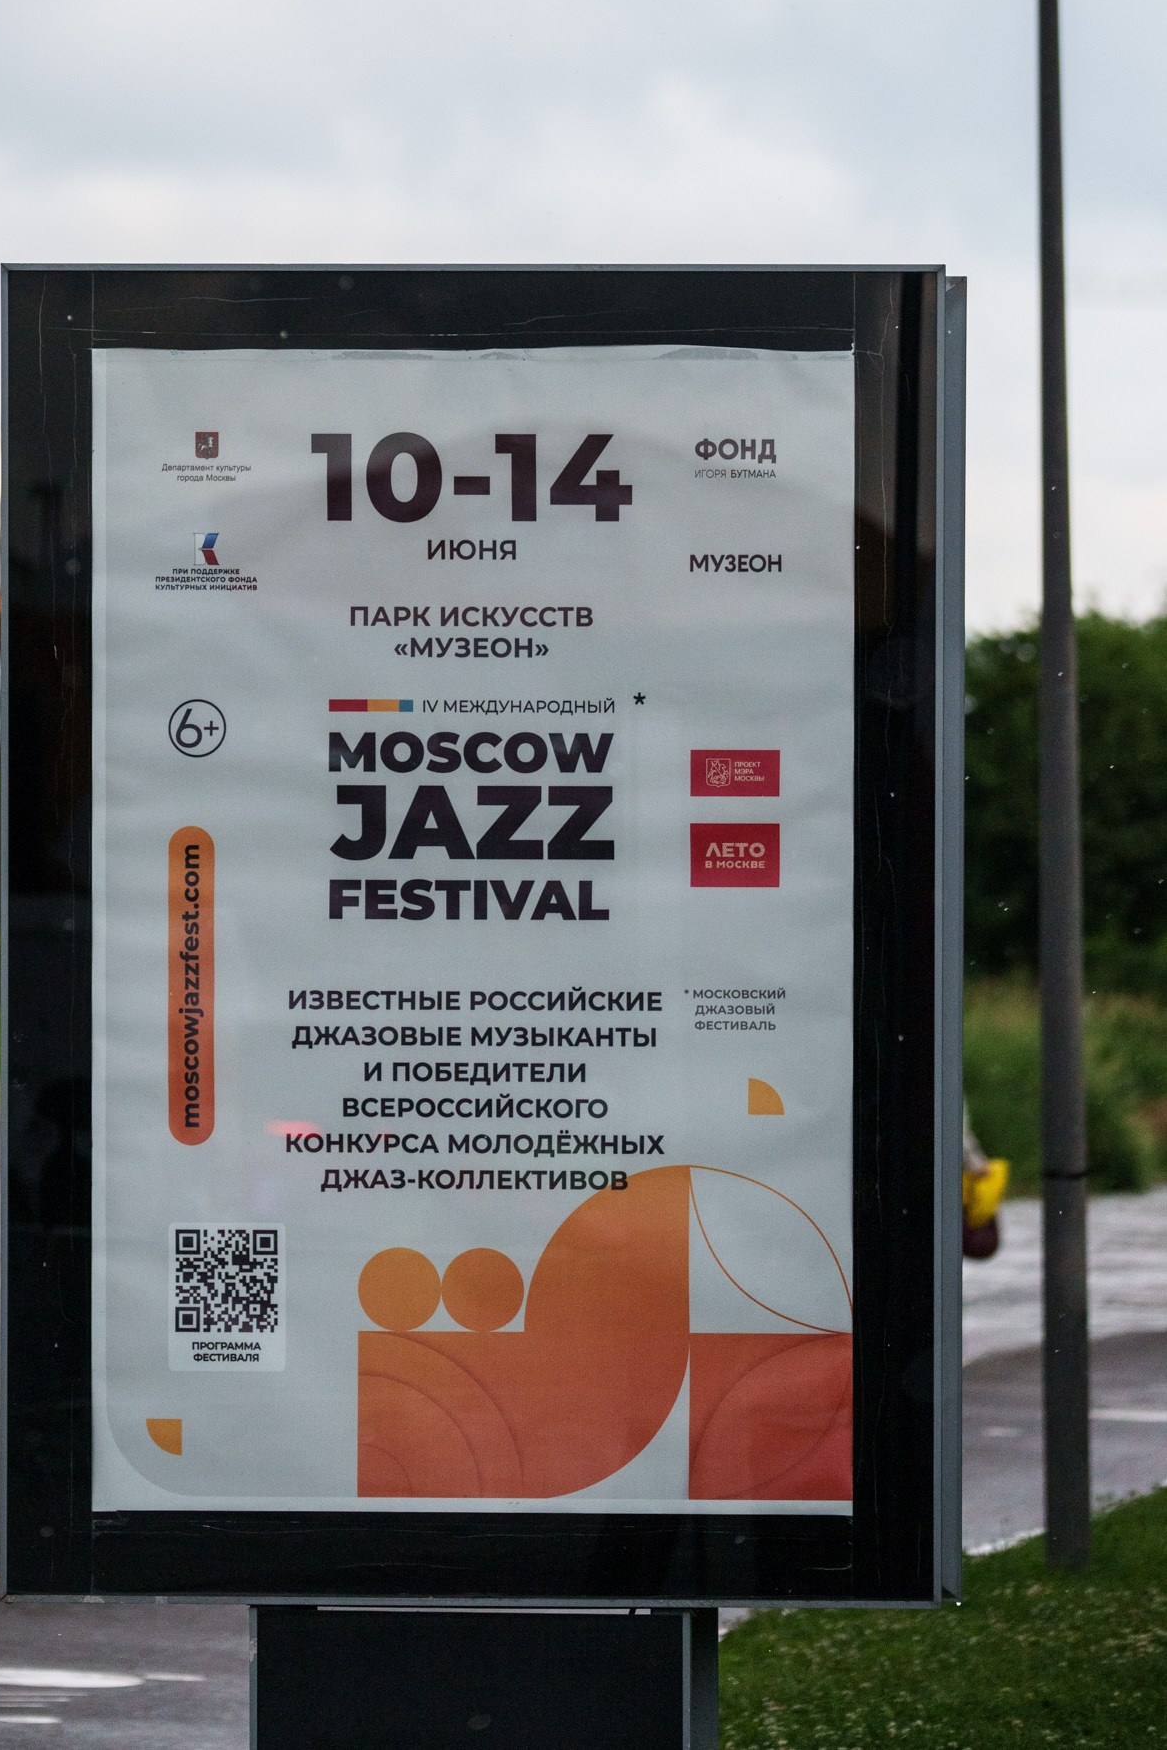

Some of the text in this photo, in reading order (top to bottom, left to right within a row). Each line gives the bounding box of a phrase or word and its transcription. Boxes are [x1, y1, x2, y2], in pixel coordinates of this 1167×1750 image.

[695, 438, 776, 463] ФОНД
[161, 463, 252, 474] Департамент культуры
[176, 473, 237, 483] города Москвы
[312, 432, 632, 523] 10-14
[694, 468, 777, 479] ИГОРЯ БУТМАНА
[428, 540, 516, 560] ИЮНЯ
[190, 568, 240, 576] ПОДДЕРЖКЕ
[690, 554, 781, 572] МУЗЕОН
[155, 576, 258, 584] ПРЕЗИДЕНТСКОГО ФОНДА
[155, 583, 258, 592] КУЛЬТУРНЫХ ИНИЦИАТИВ
[351, 607, 593, 627] ПАРК ИСКУССТВ
[395, 638, 548, 658] «МУЗЕОН»
[422, 698, 614, 715] IV МЕЖДУНАРОДНЫЙ
[176, 708, 219, 748] 6+
[329, 732, 614, 773] MOSCOW
[734, 774, 765, 782] МОСКВЫ
[330, 785, 614, 860] JAZZ
[706, 843, 765, 857] ЛЕТО
[704, 860, 766, 869] В МОСКВЕ
[329, 879, 609, 920] FESTIVAL
[179, 845, 203, 1128] moscowjazzfest.com
[692, 987, 786, 1000] МОСКОВСКИЙ
[289, 987, 662, 1011] ИЗВЕСТНЫЕ РОССИЙСКИЕ
[694, 1002, 776, 1017] ДЖАЗОВЫЙ
[694, 1020, 777, 1031] ФЕСТИВАЛЬ
[292, 1026, 656, 1049] ДЖАЗОВЫЕ МУЗЫКАНТЫ
[365, 1062, 585, 1085] И ПОБЕДИТЕЛИ
[343, 1094, 608, 1118] ВСЕРОССИЙСКОГО
[287, 1130, 664, 1157] КОНКУРСА МОЛОДЁЖНЫХ
[321, 1170, 628, 1193] ДЖАЗ-КОЛЛЕКТИВОВ
[191, 1341, 262, 1351] ПРОГРАММА
[193, 1352, 260, 1362] ФЕСТИВАЛЯ
